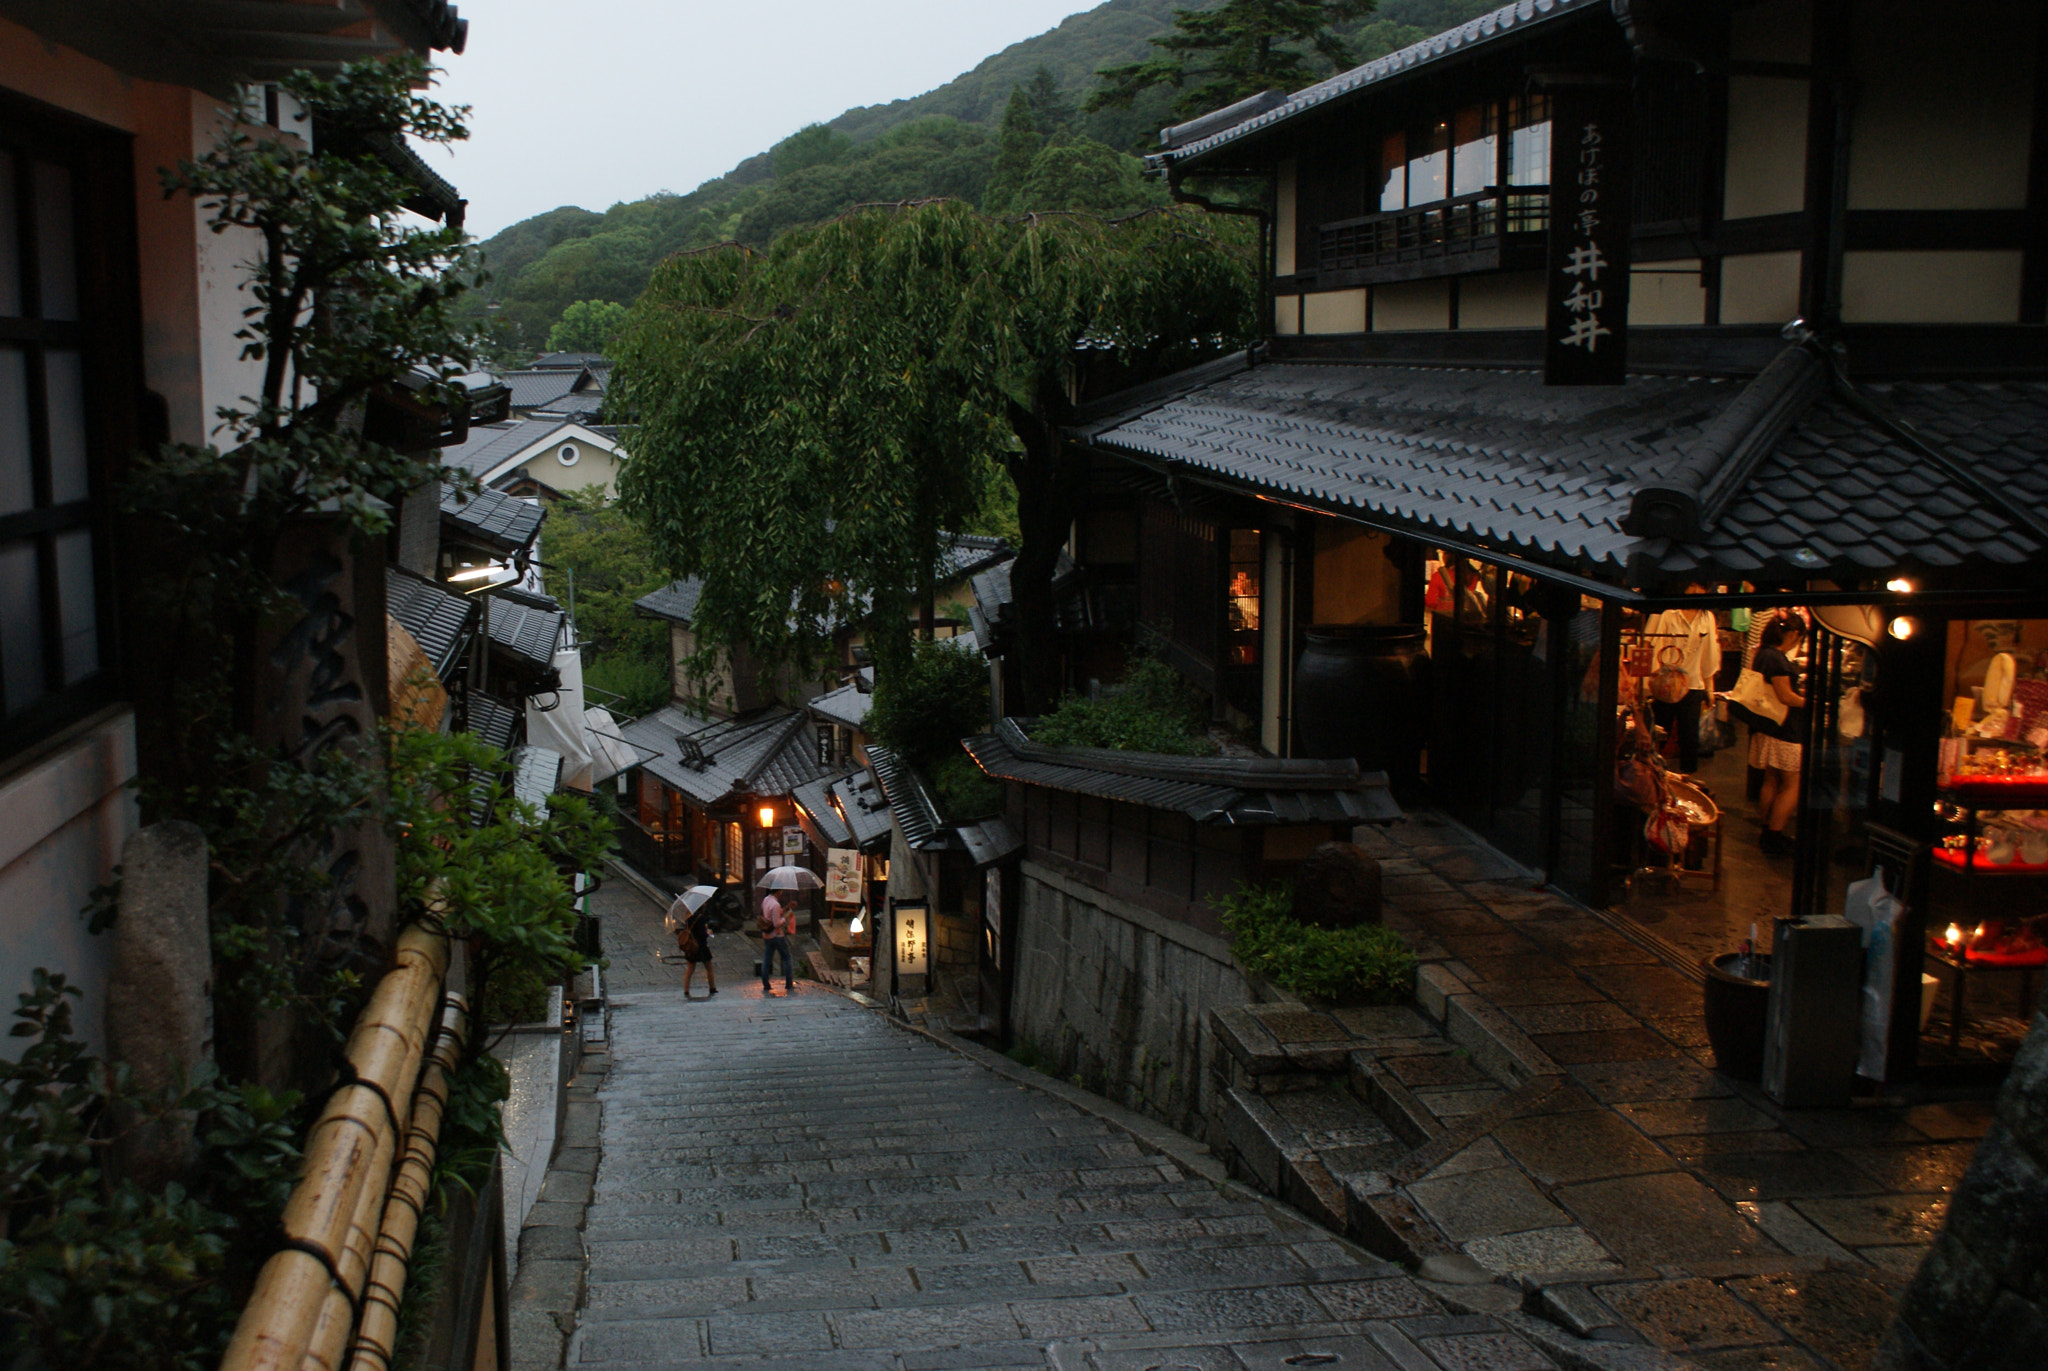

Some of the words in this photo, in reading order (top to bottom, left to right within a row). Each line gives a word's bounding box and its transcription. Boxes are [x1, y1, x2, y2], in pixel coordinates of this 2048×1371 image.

[1573, 123, 1604, 237] あけぼの亭
[1559, 240, 1612, 353] 井和井
